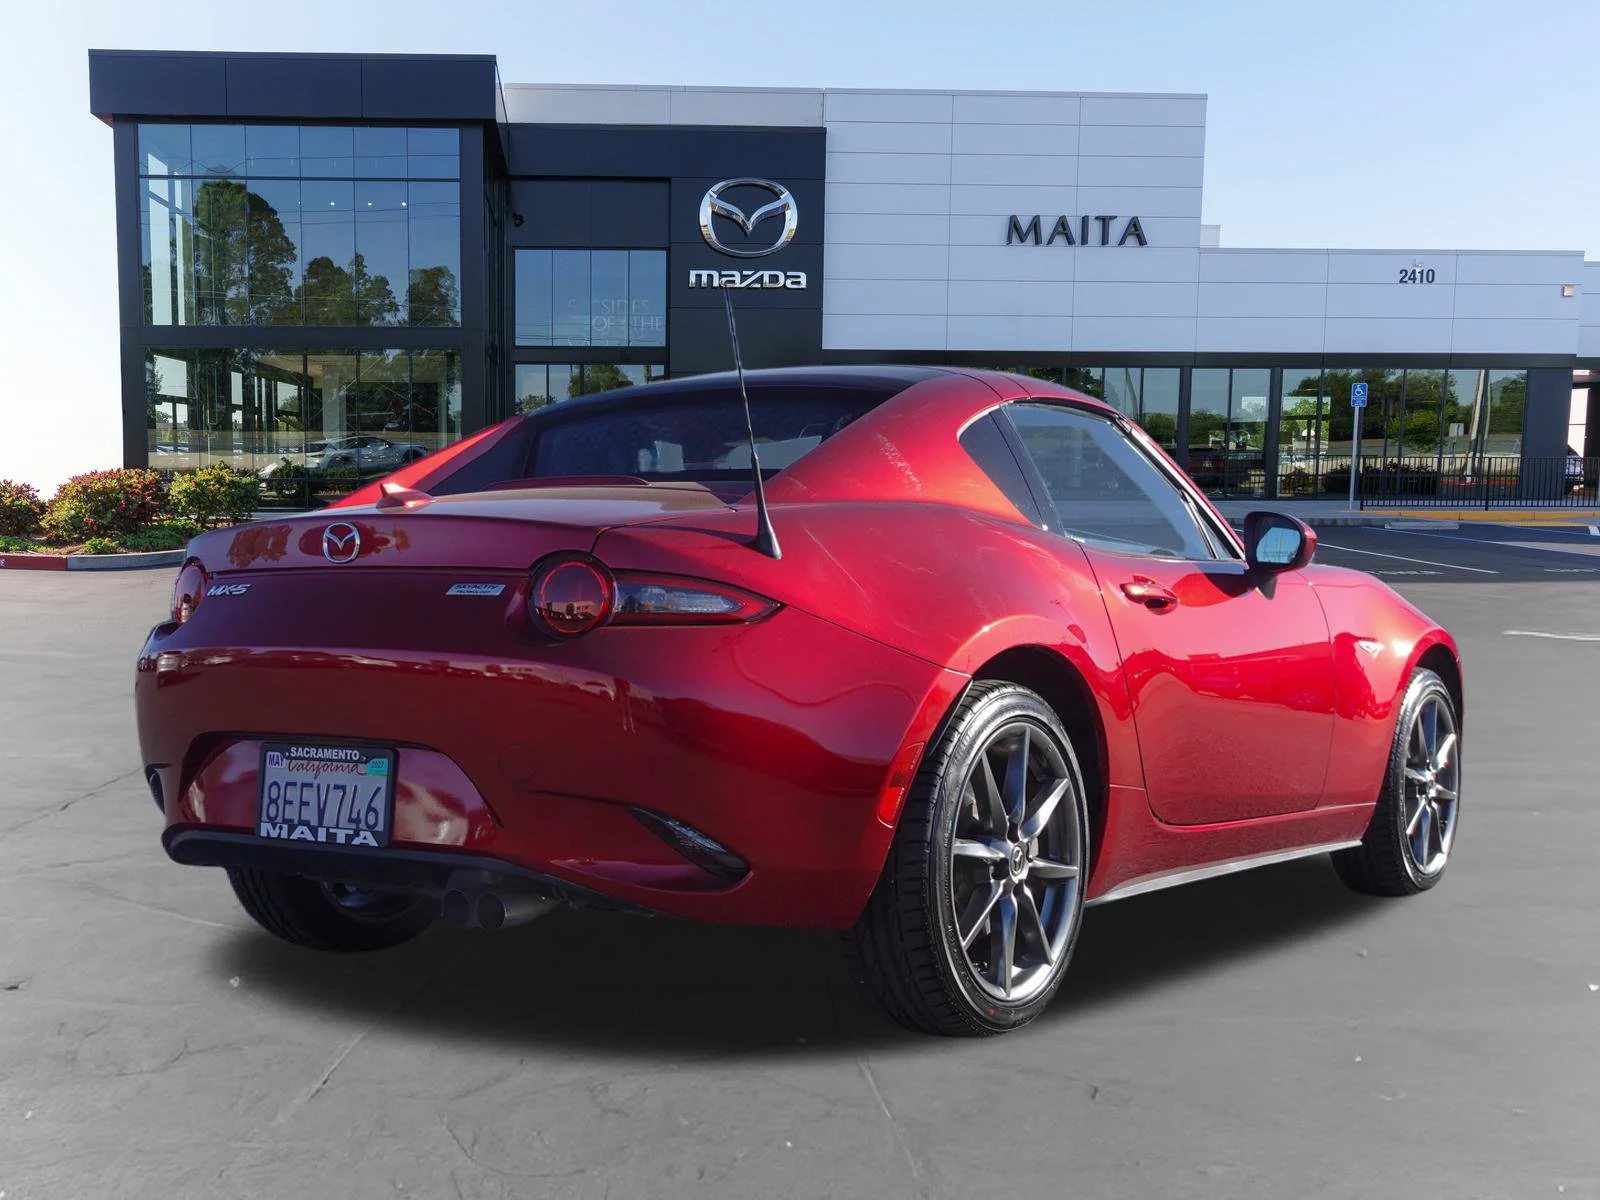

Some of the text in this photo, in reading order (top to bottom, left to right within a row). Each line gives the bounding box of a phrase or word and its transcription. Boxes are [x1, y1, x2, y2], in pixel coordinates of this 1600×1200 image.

[1006, 215, 1148, 246] MAITA
[1399, 268, 1436, 284] 2410
[592, 315, 615, 332] OF
[268, 753, 285, 767] MAY
[290, 747, 360, 761] SACRAMENTO
[266, 780, 382, 830] 8EEV746
[260, 822, 379, 847] MAITA
